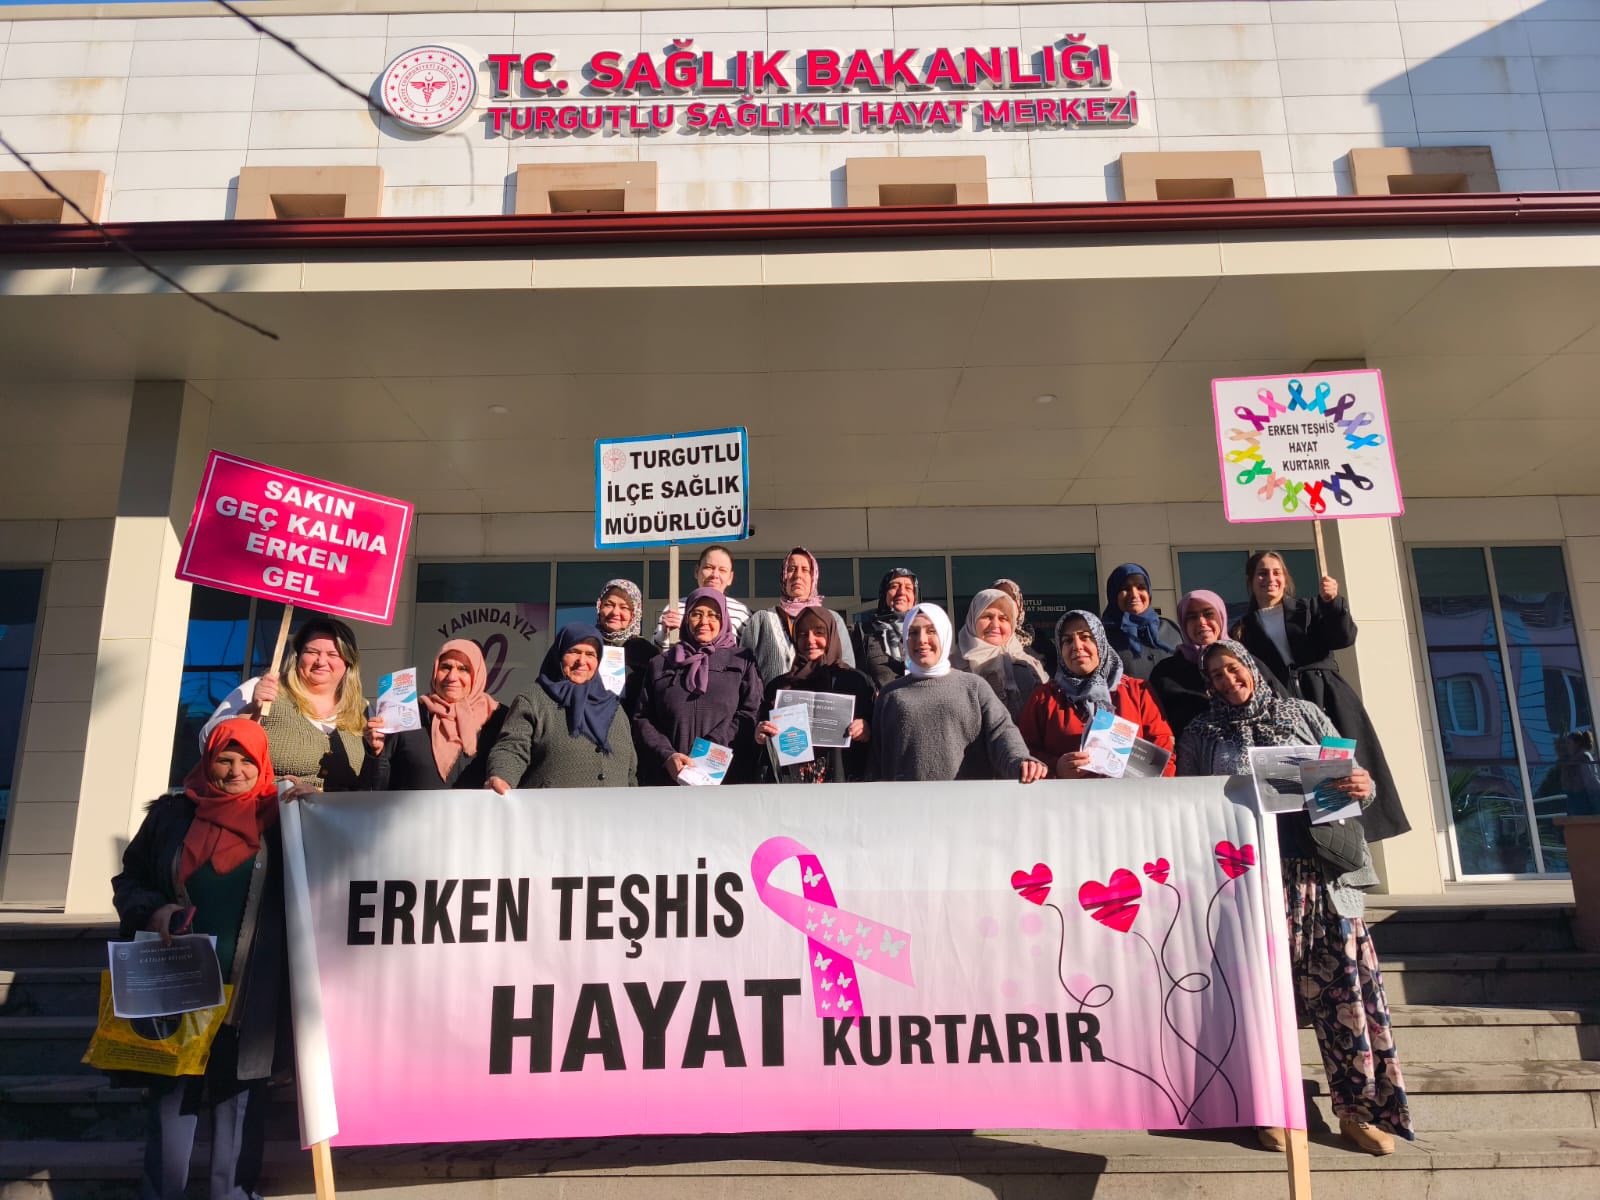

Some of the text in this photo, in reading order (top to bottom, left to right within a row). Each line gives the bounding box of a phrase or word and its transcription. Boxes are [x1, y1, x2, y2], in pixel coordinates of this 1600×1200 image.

[488, 33, 1112, 91] TC. SAĞLIK BAKANLIĞI
[488, 90, 1138, 132] TURGUTLU SAĞLIKLI HAYAT MERKEZİ
[1268, 421, 1335, 436] ERKEN TEŞHİS
[629, 443, 740, 470] TURGUTLU
[1289, 441, 1318, 453] HAYAT
[1282, 458, 1331, 471] KURTARIR
[264, 480, 356, 520] SAKIN
[607, 474, 740, 506] İLÇE SAĞLIK
[215, 496, 387, 556] GEÇ KALMA
[605, 505, 742, 535] MÜDÜRLÜĞÜ
[245, 532, 348, 574] ERKEN
[262, 566, 320, 597] GEL
[437, 607, 538, 641] YANINDAYIZ
[347, 857, 744, 959] ERKEN TEŞHİS
[489, 979, 1105, 1074] HAYAT KURTARIR
